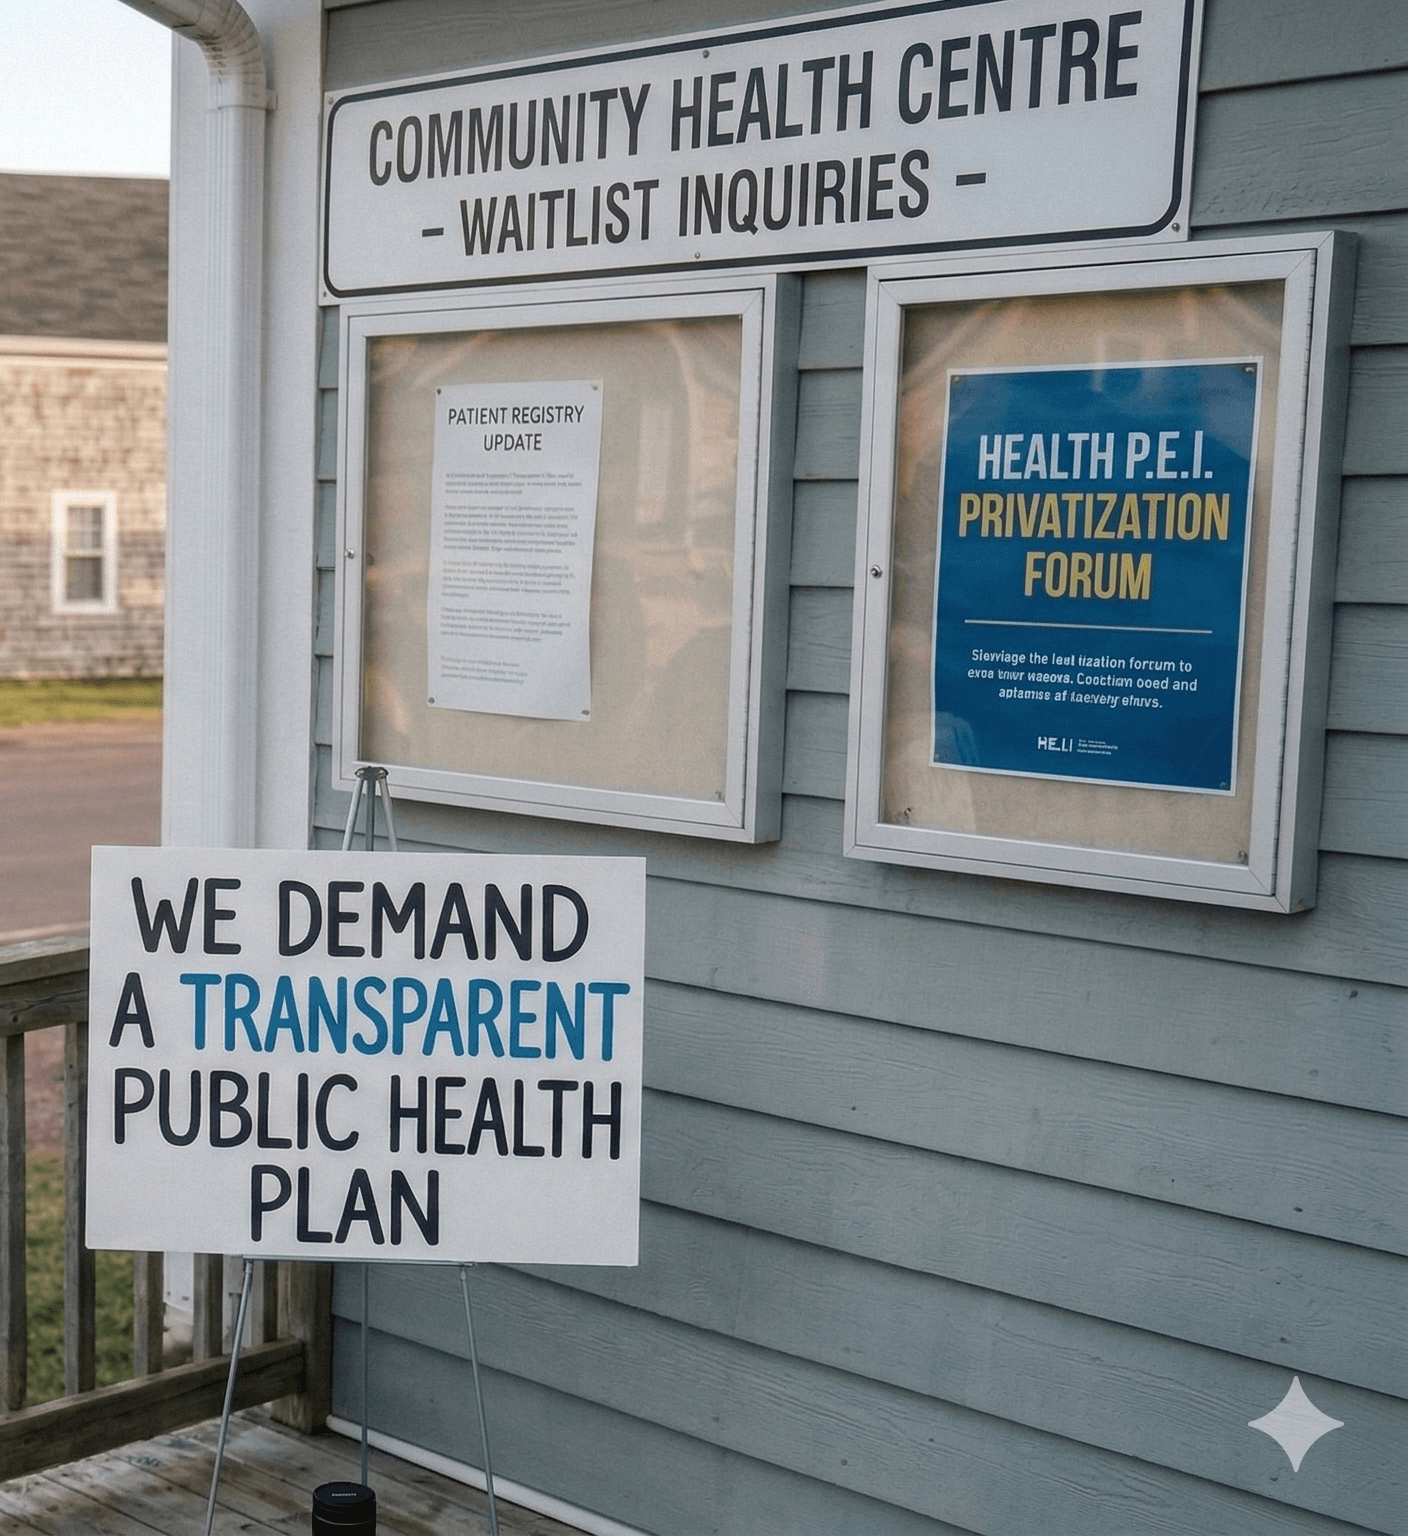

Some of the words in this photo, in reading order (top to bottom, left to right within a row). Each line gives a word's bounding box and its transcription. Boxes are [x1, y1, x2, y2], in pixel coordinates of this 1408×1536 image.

[370, 83, 652, 186] COMMUNITY
[671, 51, 873, 152] HEALTH
[898, 10, 1142, 124] CENTRE
[460, 179, 660, 256] WAITLIST
[679, 149, 929, 236] INQUIRIES
[448, 408, 508, 425] PATIENT
[512, 405, 584, 424] REGISTRY
[484, 434, 542, 451] UPDATE
[978, 433, 1114, 480] HEALTH
[1126, 431, 1213, 479] P.E.I.
[959, 493, 1230, 540] PRIVATIZATION
[1024, 552, 1152, 600] FORUM
[1030, 652, 1048, 664] the
[1180, 660, 1192, 672] to
[1173, 679, 1197, 691] and
[131, 877, 242, 955] WE
[278, 880, 589, 962] DEMAND
[109, 972, 155, 1049] A
[179, 973, 631, 1061] TRANSPARENT
[114, 1068, 359, 1152] PUBLIC
[389, 1075, 621, 1159] HEALTH
[250, 1165, 440, 1246] PLAN
